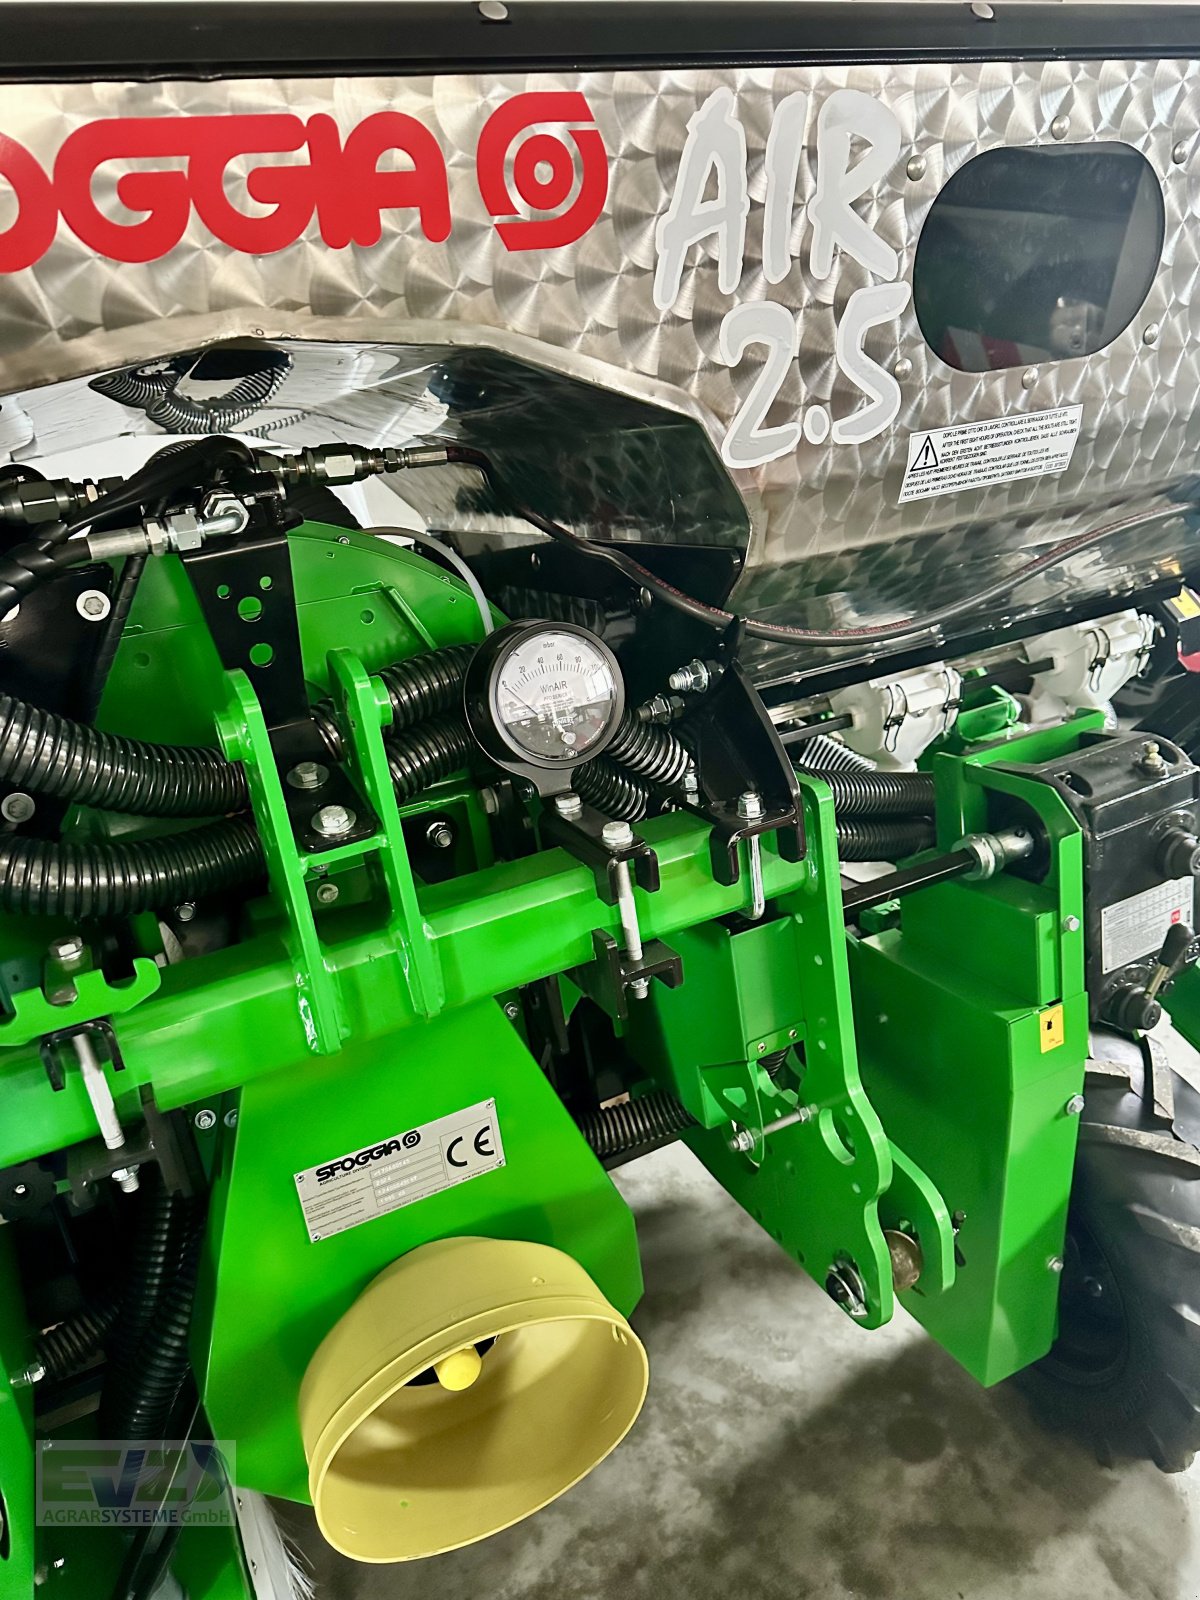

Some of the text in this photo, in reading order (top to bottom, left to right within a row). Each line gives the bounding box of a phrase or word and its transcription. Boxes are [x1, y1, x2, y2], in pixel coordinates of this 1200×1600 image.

[653, 86, 902, 310] AIR
[718, 281, 912, 469] 2.5
[518, 665, 526, 674] 20
[537, 656, 544, 665] 40
[556, 653, 564, 661] 60
[574, 655, 582, 663] 80
[539, 680, 568, 693] WinAIR
[315, 1139, 401, 1183] SFOGGIA
[446, 1125, 495, 1168] CE
[319, 1170, 352, 1187] AGRICULTURE
